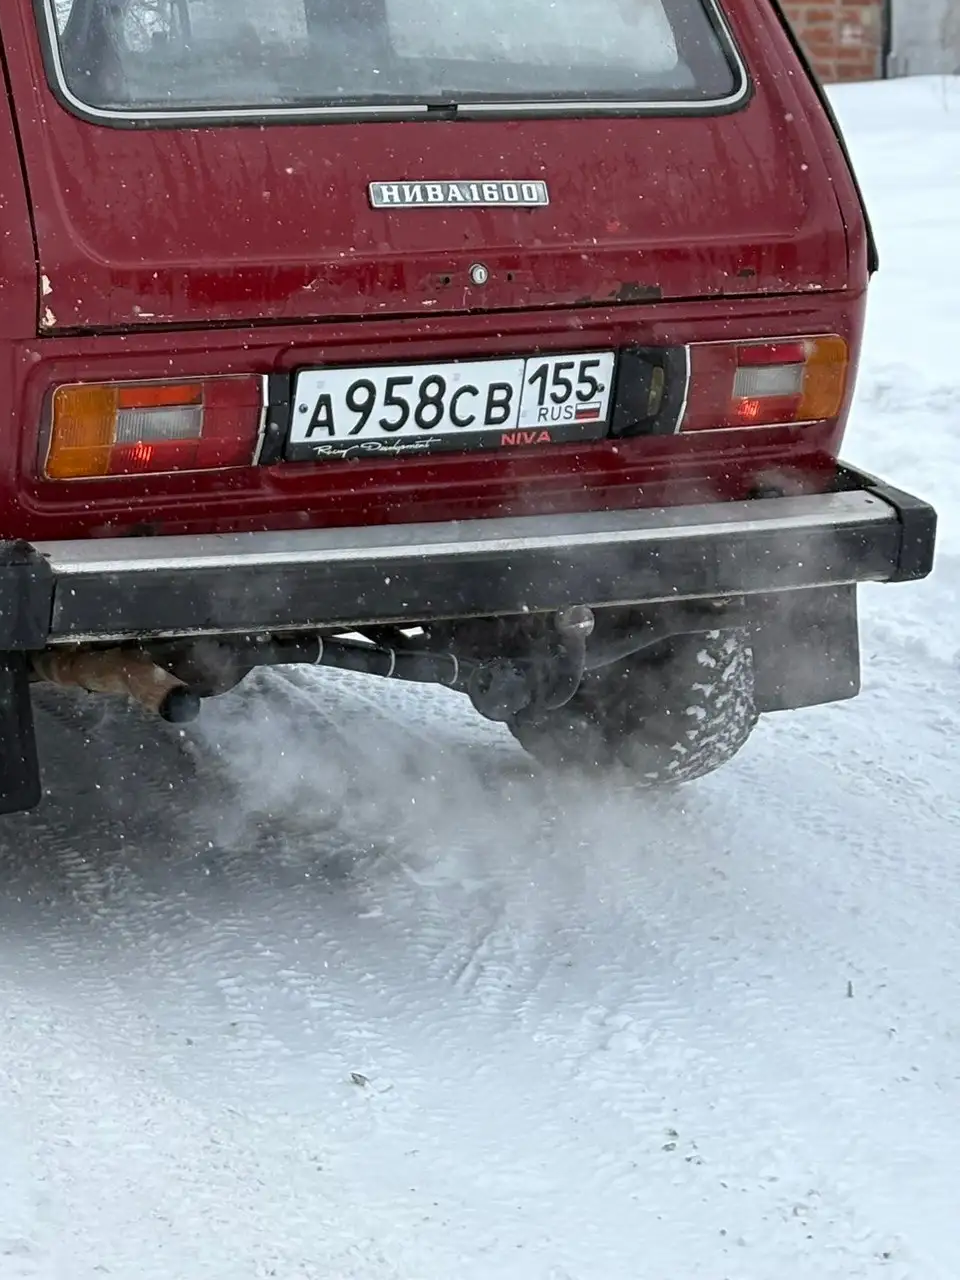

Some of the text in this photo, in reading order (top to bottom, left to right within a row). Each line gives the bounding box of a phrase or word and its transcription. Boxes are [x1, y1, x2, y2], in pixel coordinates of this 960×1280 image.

[528, 360, 601, 405] 155
[537, 406, 574, 422] RUS
[500, 431, 551, 447] NIVA
